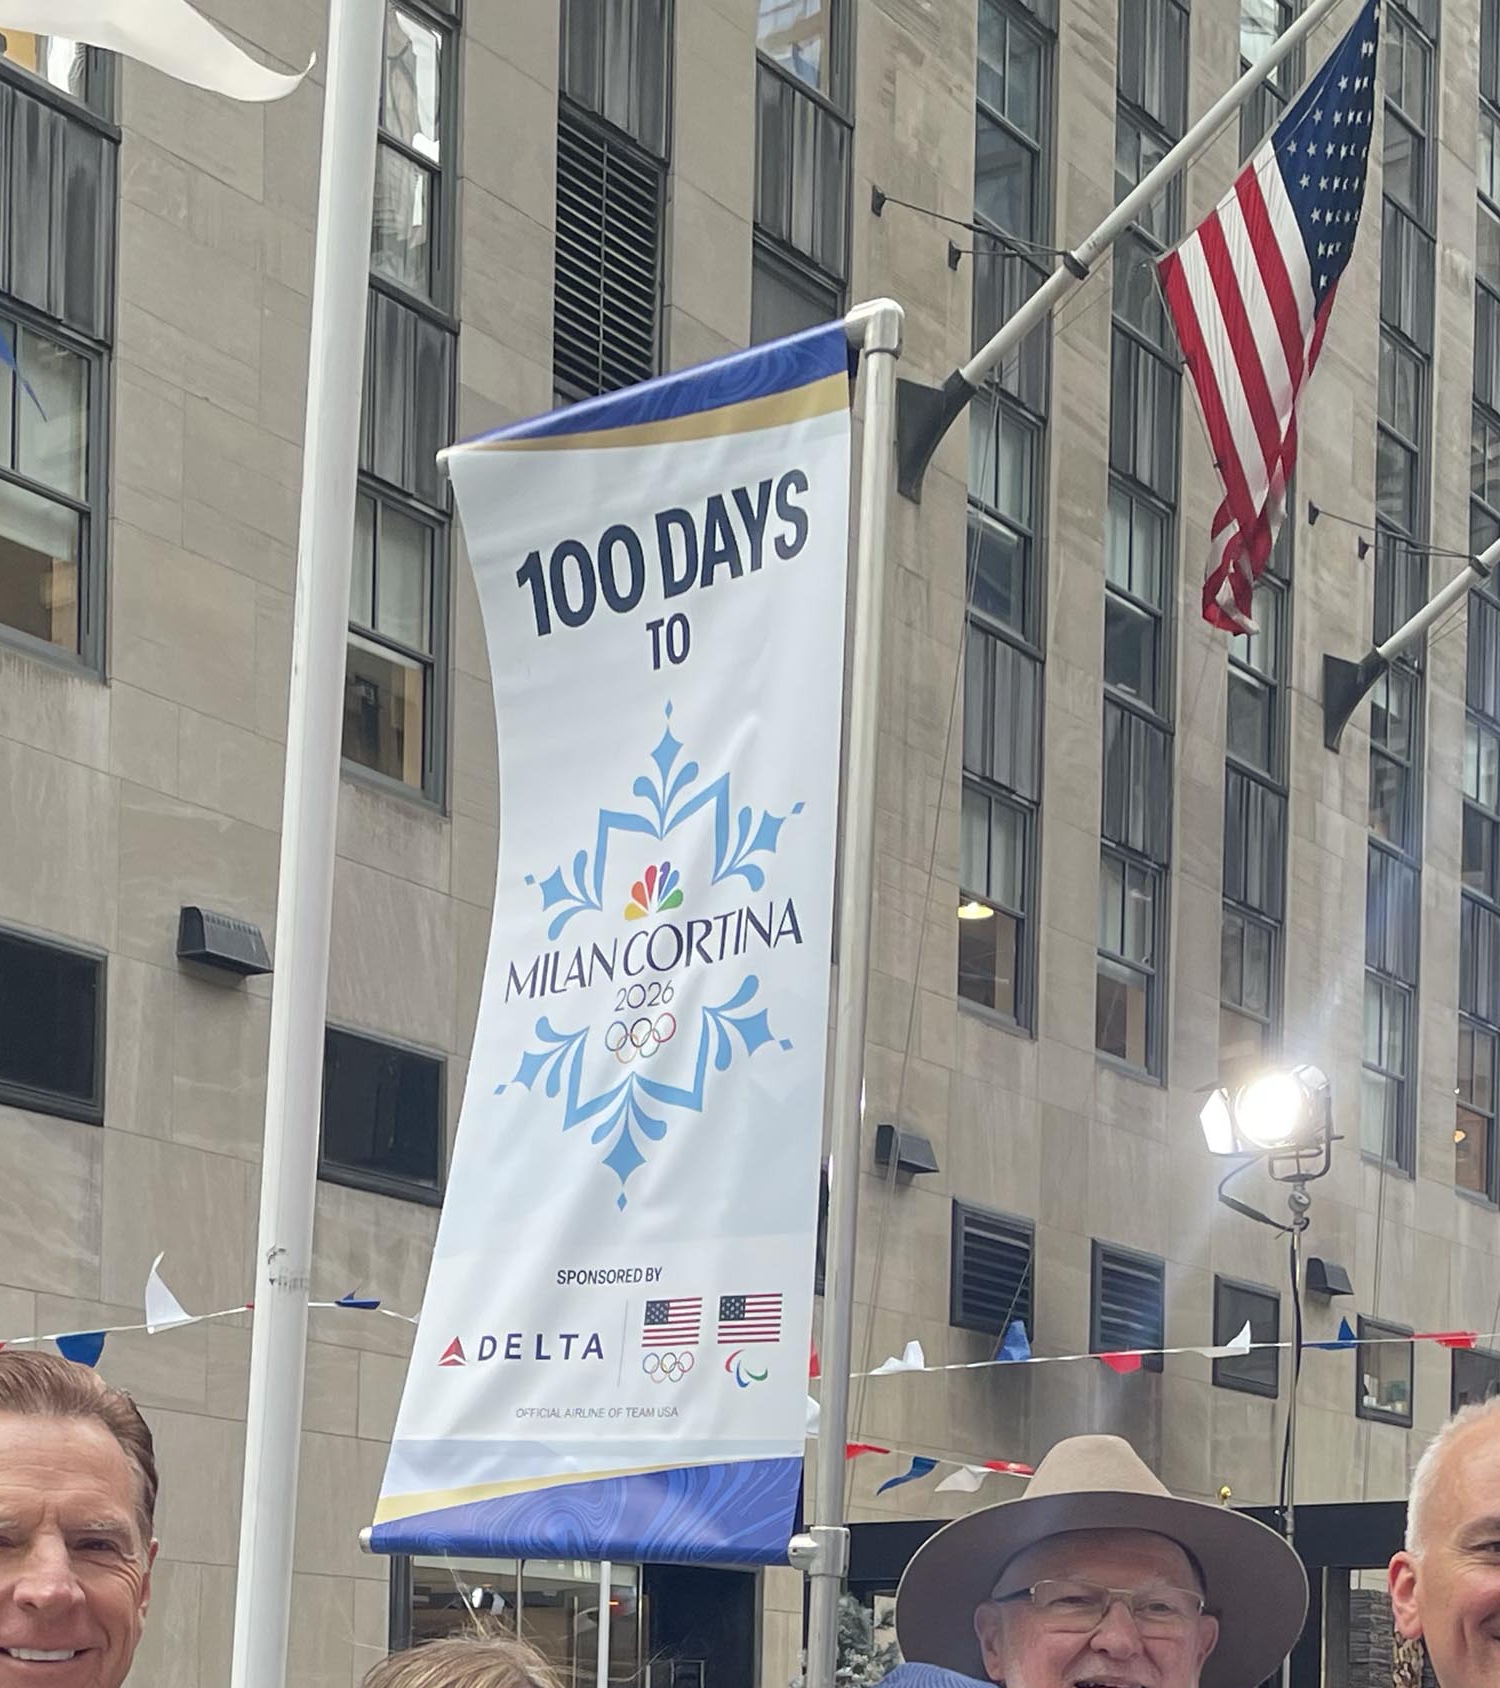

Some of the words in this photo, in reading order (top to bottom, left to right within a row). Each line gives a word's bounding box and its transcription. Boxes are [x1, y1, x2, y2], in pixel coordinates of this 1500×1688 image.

[515, 523, 646, 637] 100
[654, 468, 810, 600] DAYS
[645, 612, 692, 670] TO
[504, 936, 618, 1004] MILAN
[622, 897, 804, 977] CORTINA
[613, 979, 676, 1013] 2026
[556, 1268, 643, 1286] SPONSORED
[645, 1266, 663, 1283] BY
[477, 1332, 605, 1362] DELTA
[515, 1407, 561, 1419] OFFICIAL
[564, 1407, 605, 1418] AIRLINE
[607, 1407, 623, 1418] OF
[626, 1406, 655, 1418] TEAM
[657, 1406, 679, 1418] USA
